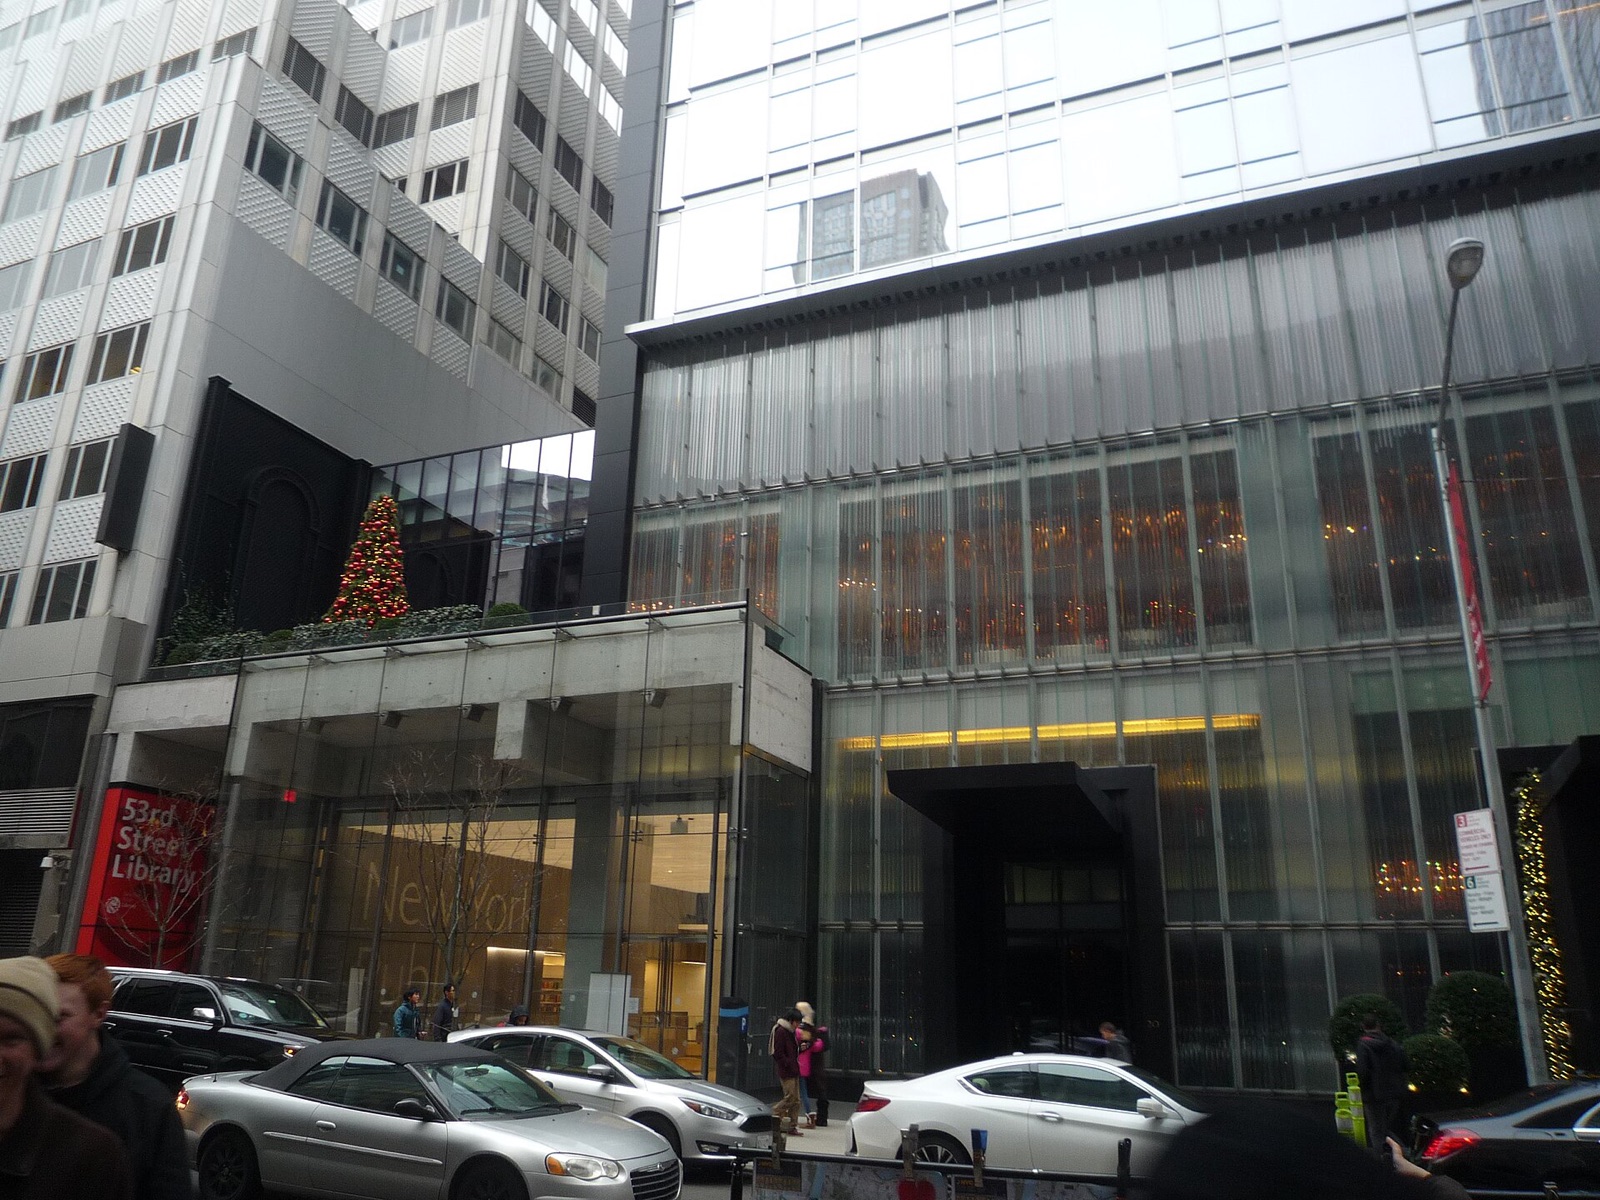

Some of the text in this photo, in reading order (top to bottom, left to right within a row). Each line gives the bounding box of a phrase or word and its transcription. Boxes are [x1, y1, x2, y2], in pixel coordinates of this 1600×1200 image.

[122, 797, 177, 827] 53rd
[1457, 815, 1466, 827] 3
[112, 854, 197, 893] Library
[1466, 877, 1475, 889] 6
